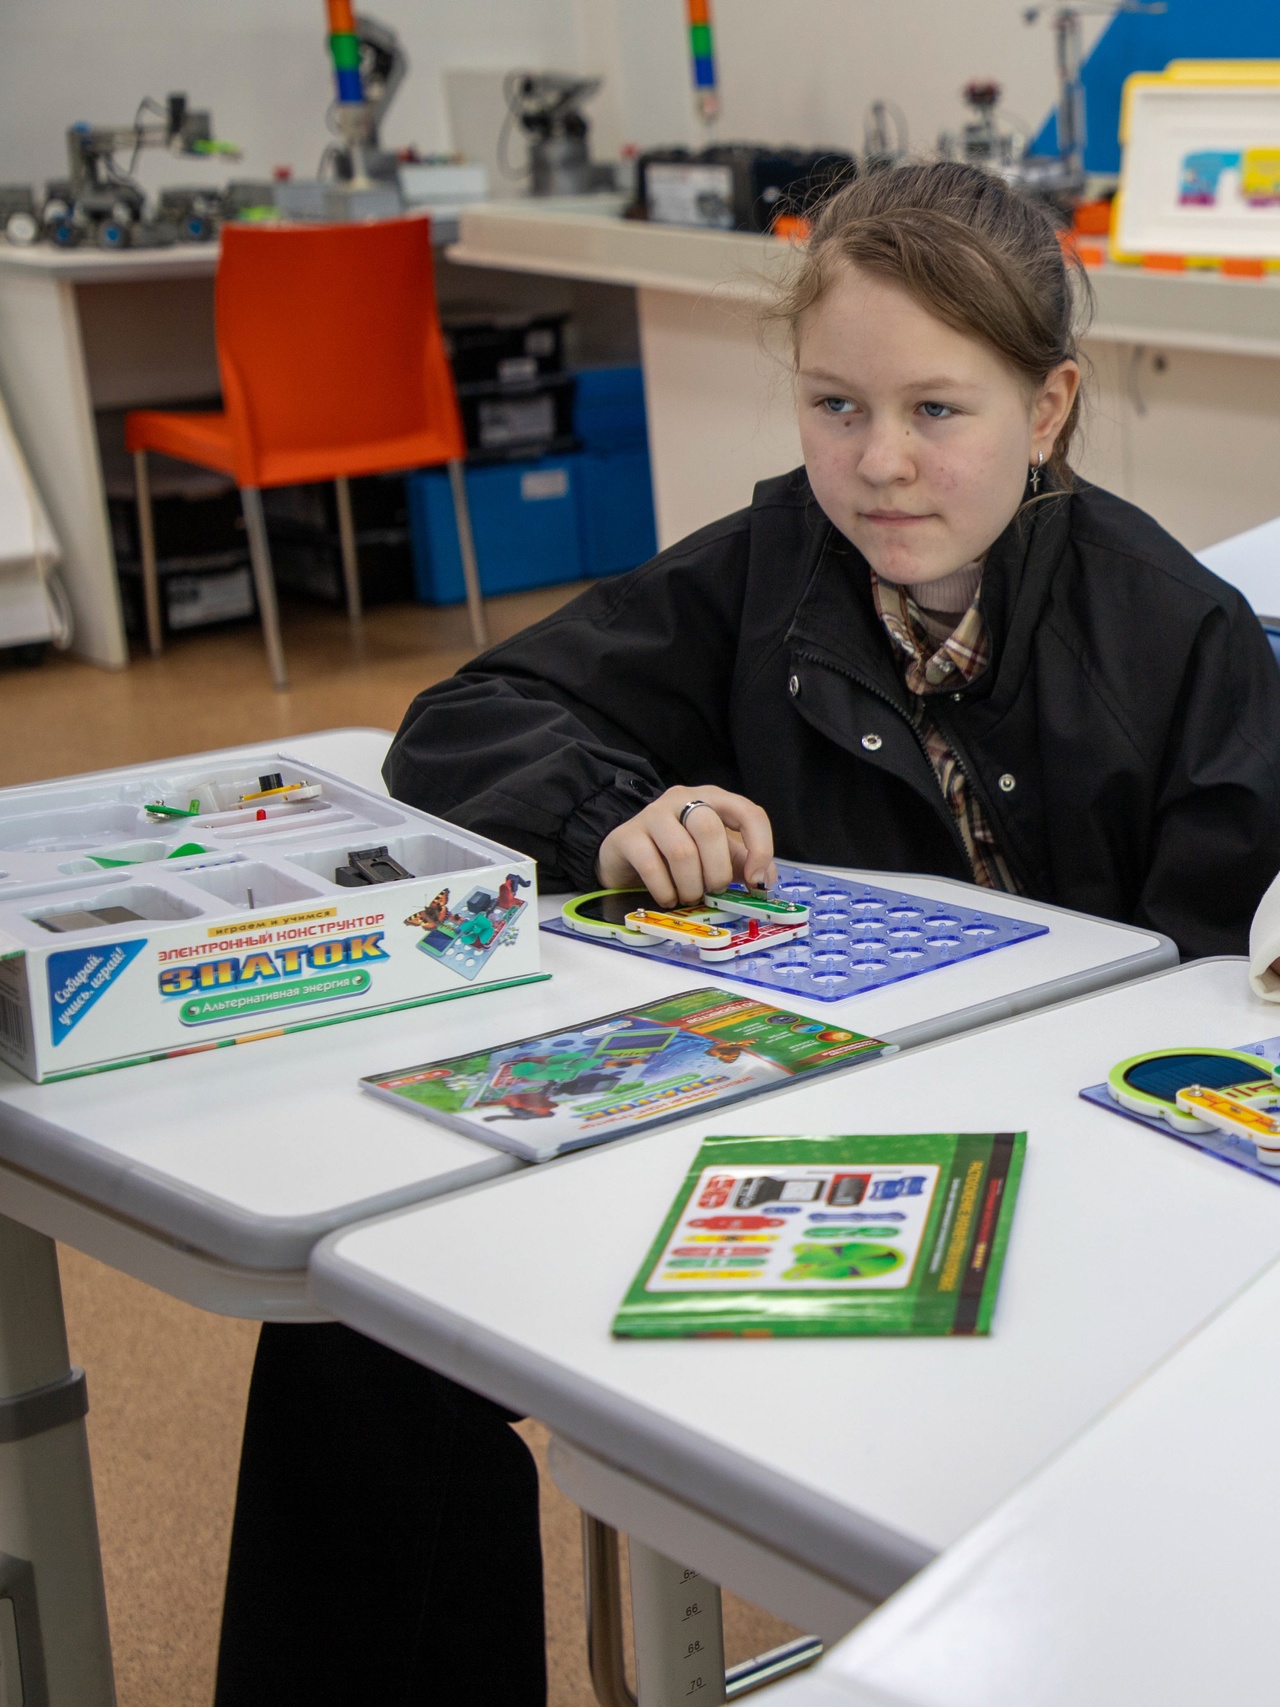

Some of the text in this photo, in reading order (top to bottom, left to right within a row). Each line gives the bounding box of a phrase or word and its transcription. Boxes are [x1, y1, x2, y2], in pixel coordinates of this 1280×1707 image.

[158, 913, 385, 961] ЭЛЕКТРОННЫЙ КОНСТРУКТОР
[215, 921, 266, 935] играем
[283, 909, 331, 925] учимся
[91, 946, 126, 989] играй!
[159, 931, 389, 996] ЗНАТОК
[202, 977, 350, 1013] Альтернативная энергия
[685, 1603, 698, 1616] 66
[688, 1640, 700, 1653] 68
[690, 1677, 702, 1690] 70
